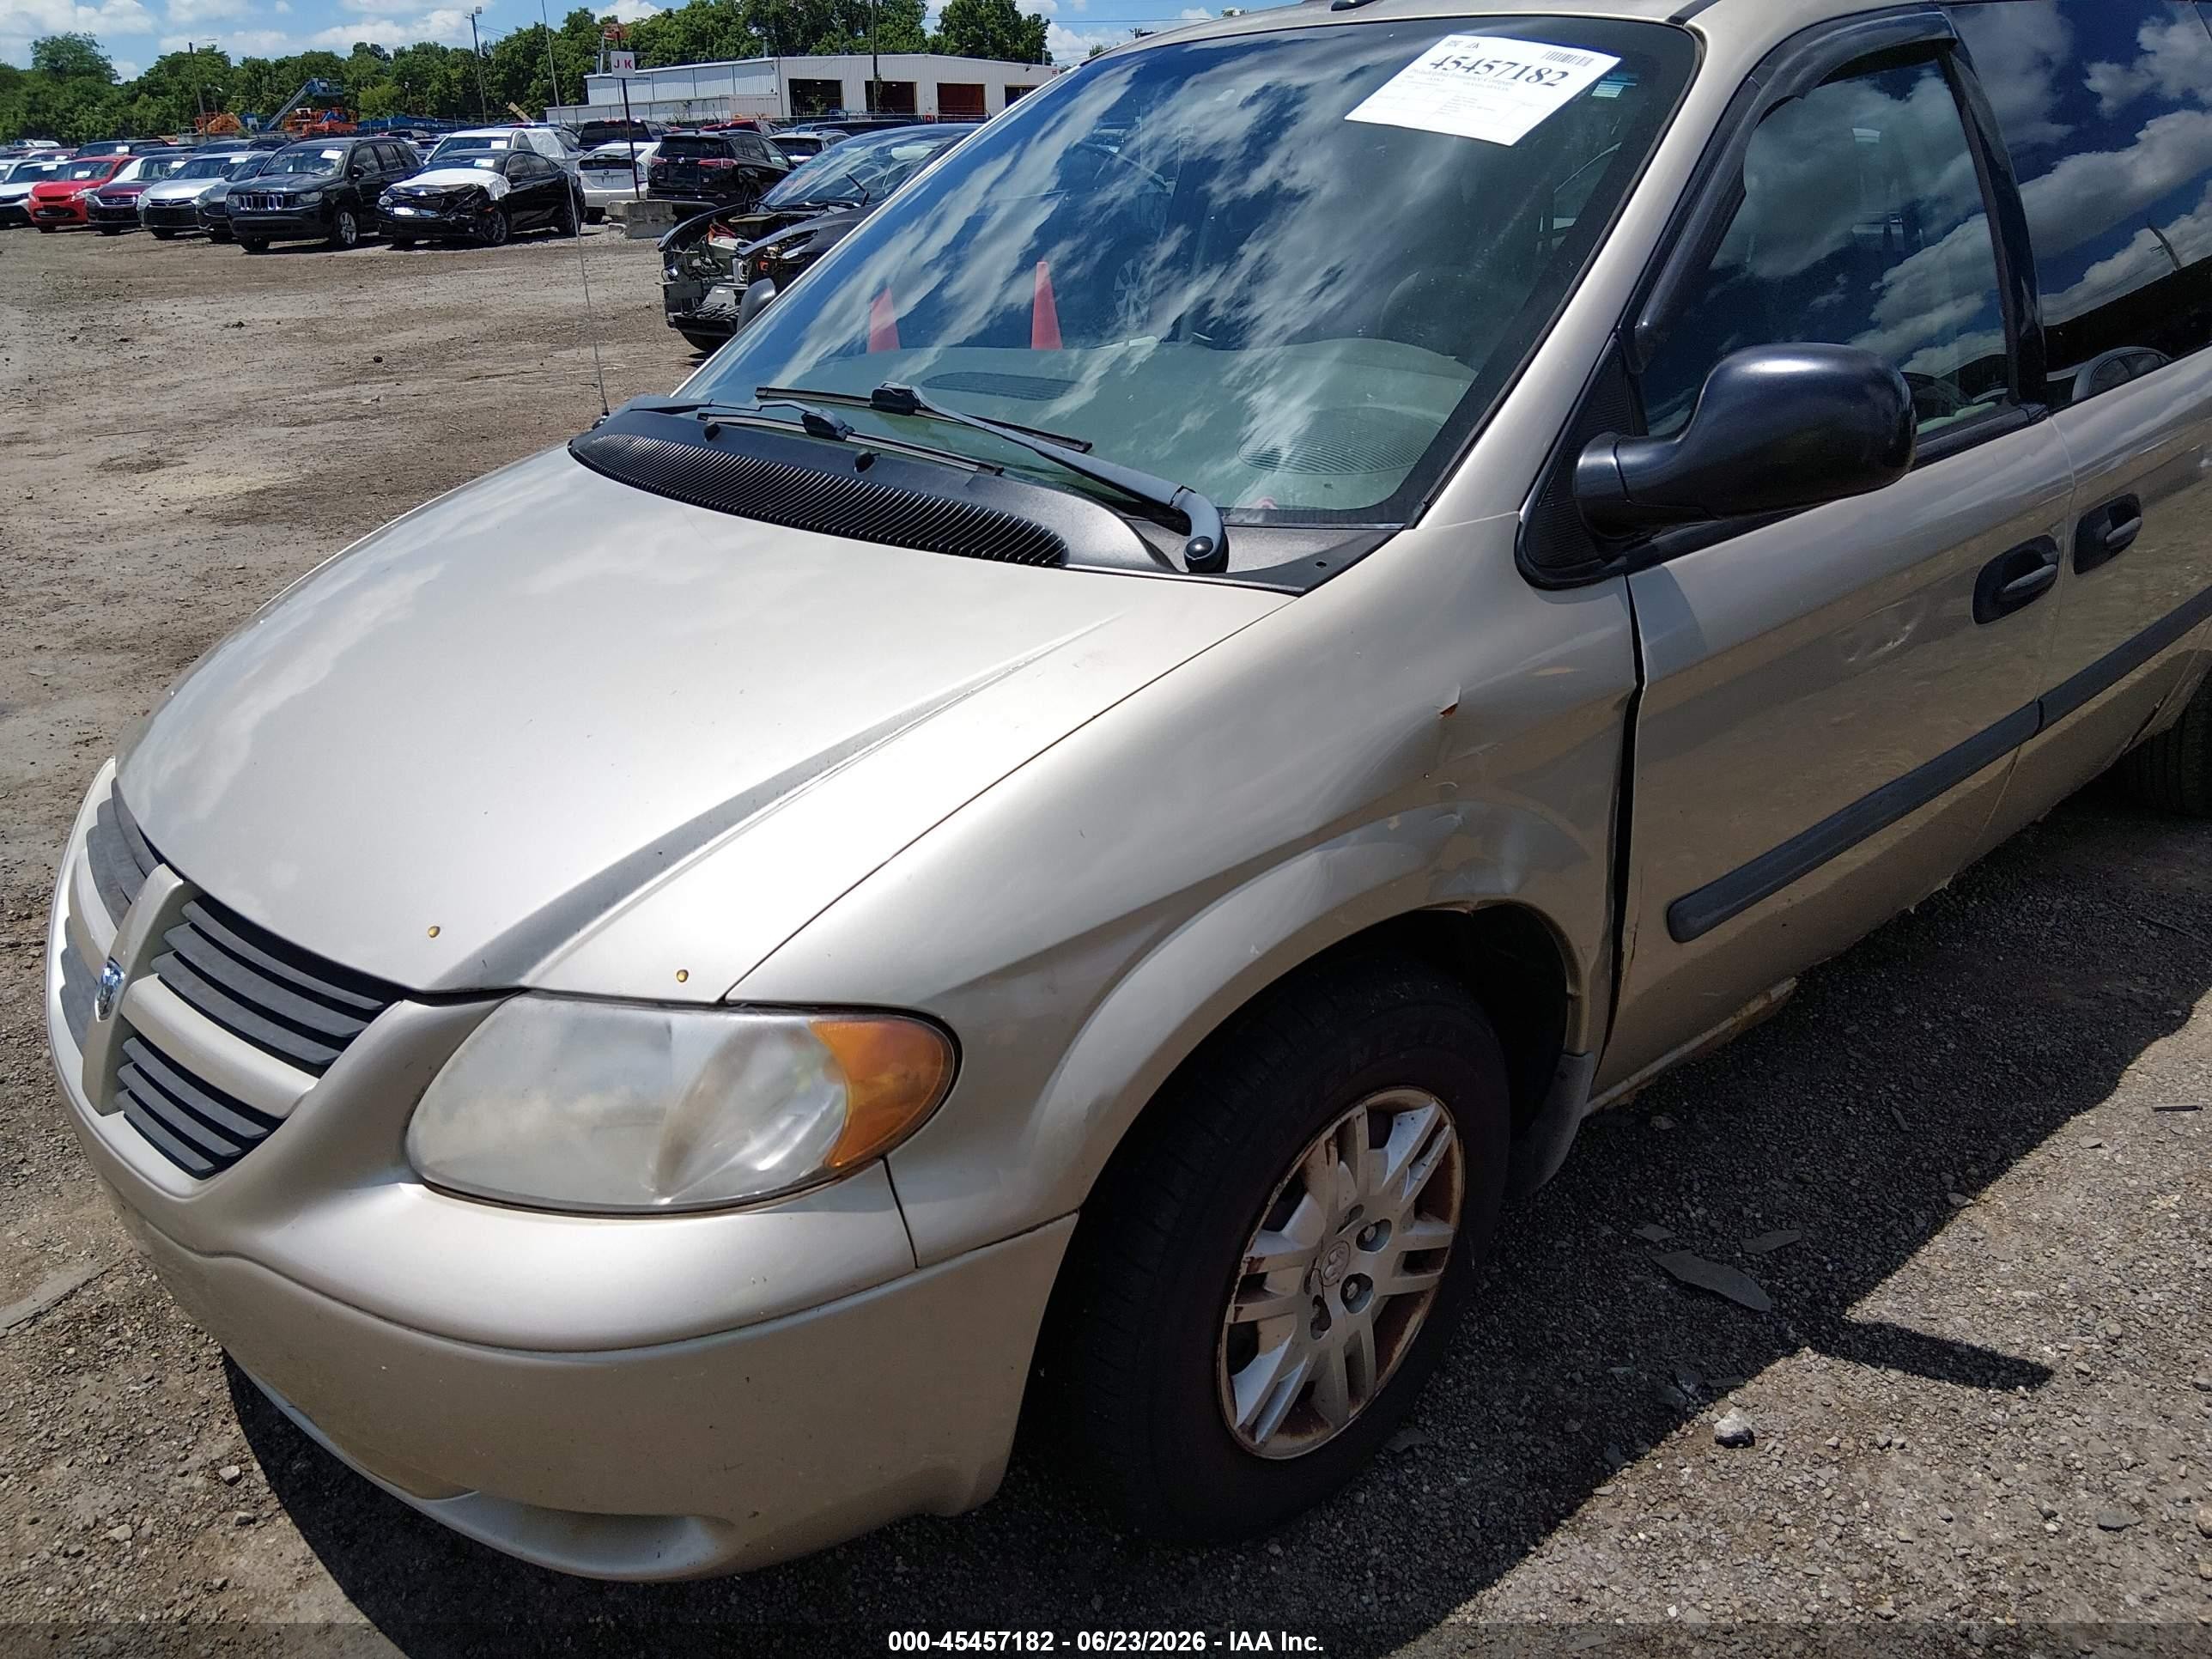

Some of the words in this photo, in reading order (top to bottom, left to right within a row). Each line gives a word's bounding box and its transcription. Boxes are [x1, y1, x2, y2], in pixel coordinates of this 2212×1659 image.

[613, 59, 620, 69] J
[624, 59, 633, 69] K
[1429, 54, 1570, 87] 45457182
